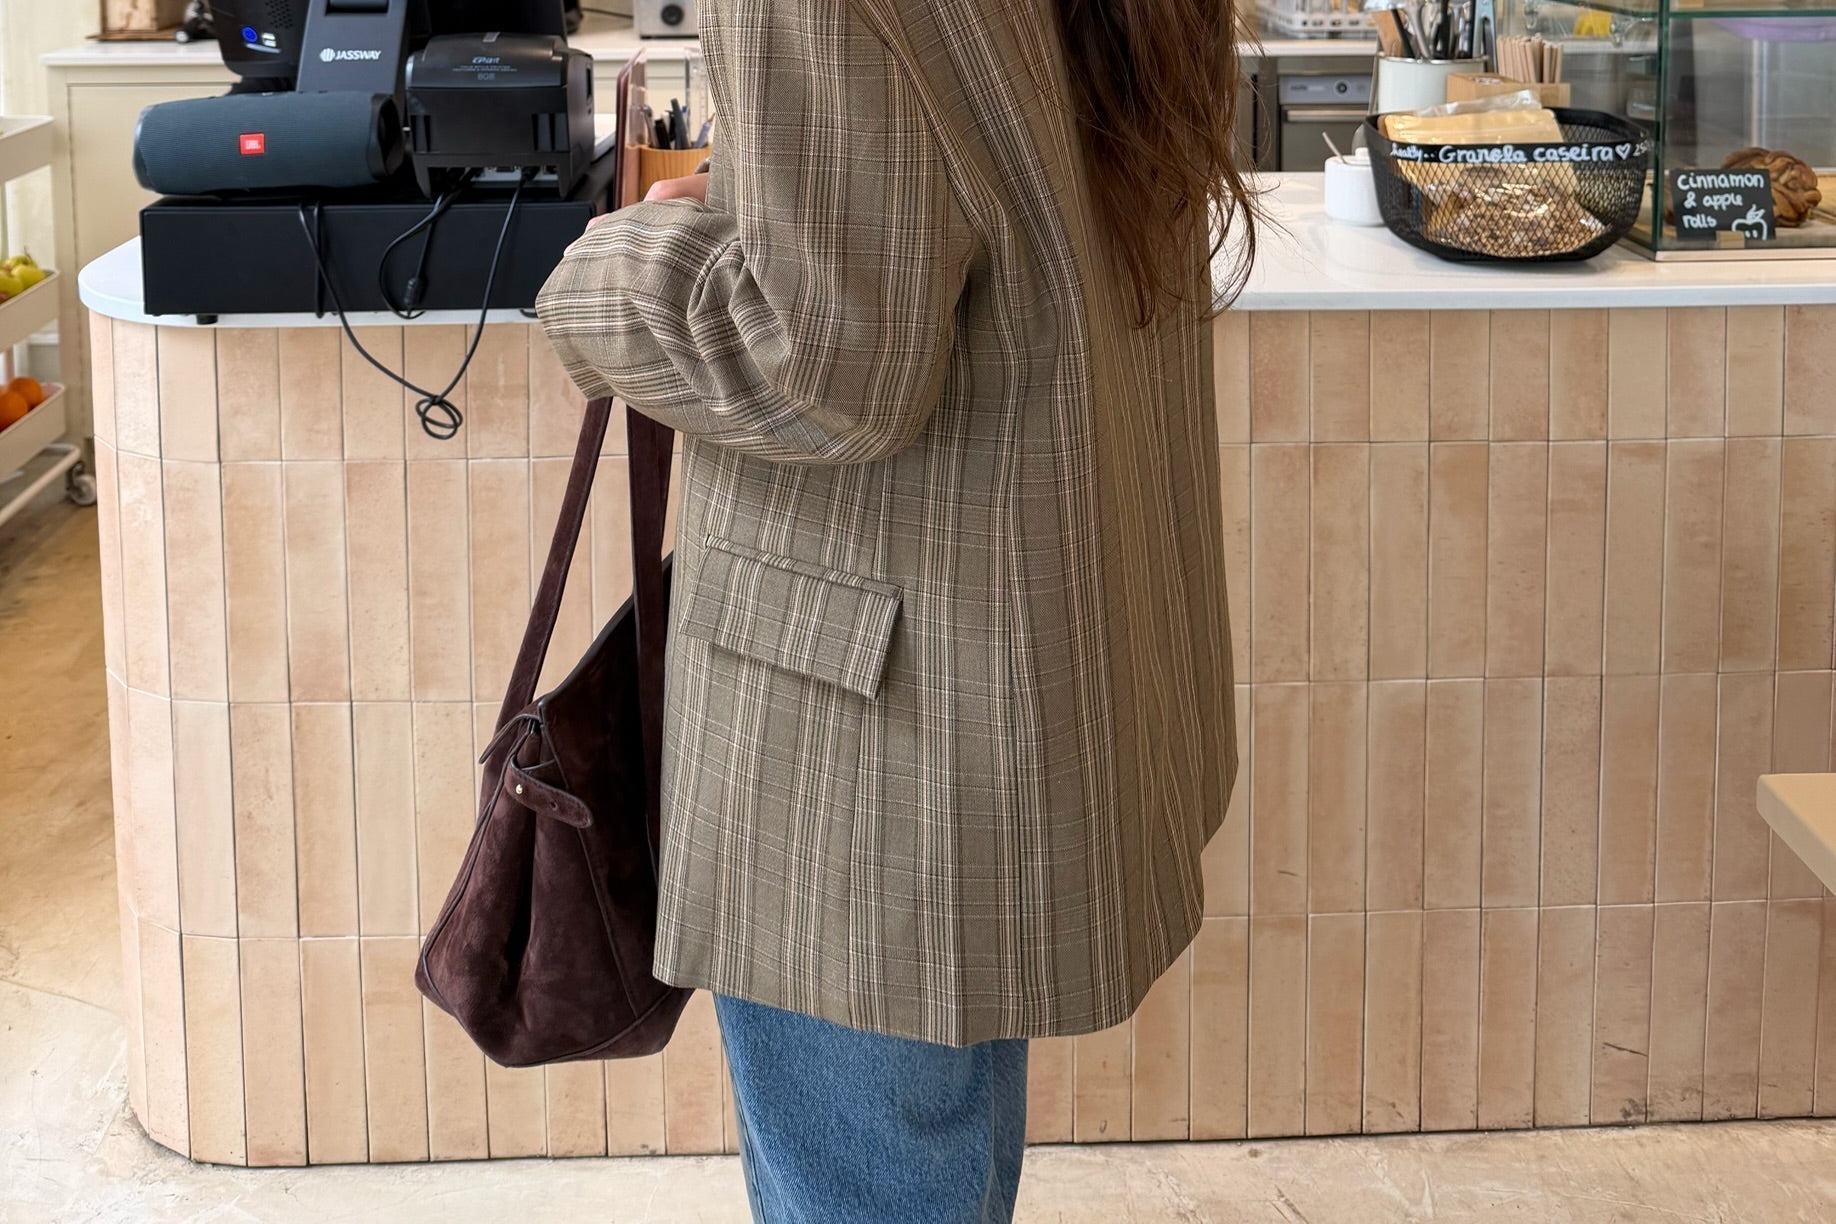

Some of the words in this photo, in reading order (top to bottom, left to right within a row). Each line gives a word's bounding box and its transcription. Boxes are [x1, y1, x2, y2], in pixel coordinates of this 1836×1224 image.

[335, 50, 381, 61] JASSWAY
[1439, 145, 1528, 163] Granola
[1533, 143, 1614, 162] caseira
[1683, 191, 1697, 209] &
[1702, 192, 1743, 211] apple
[1682, 213, 1718, 229] rolls
